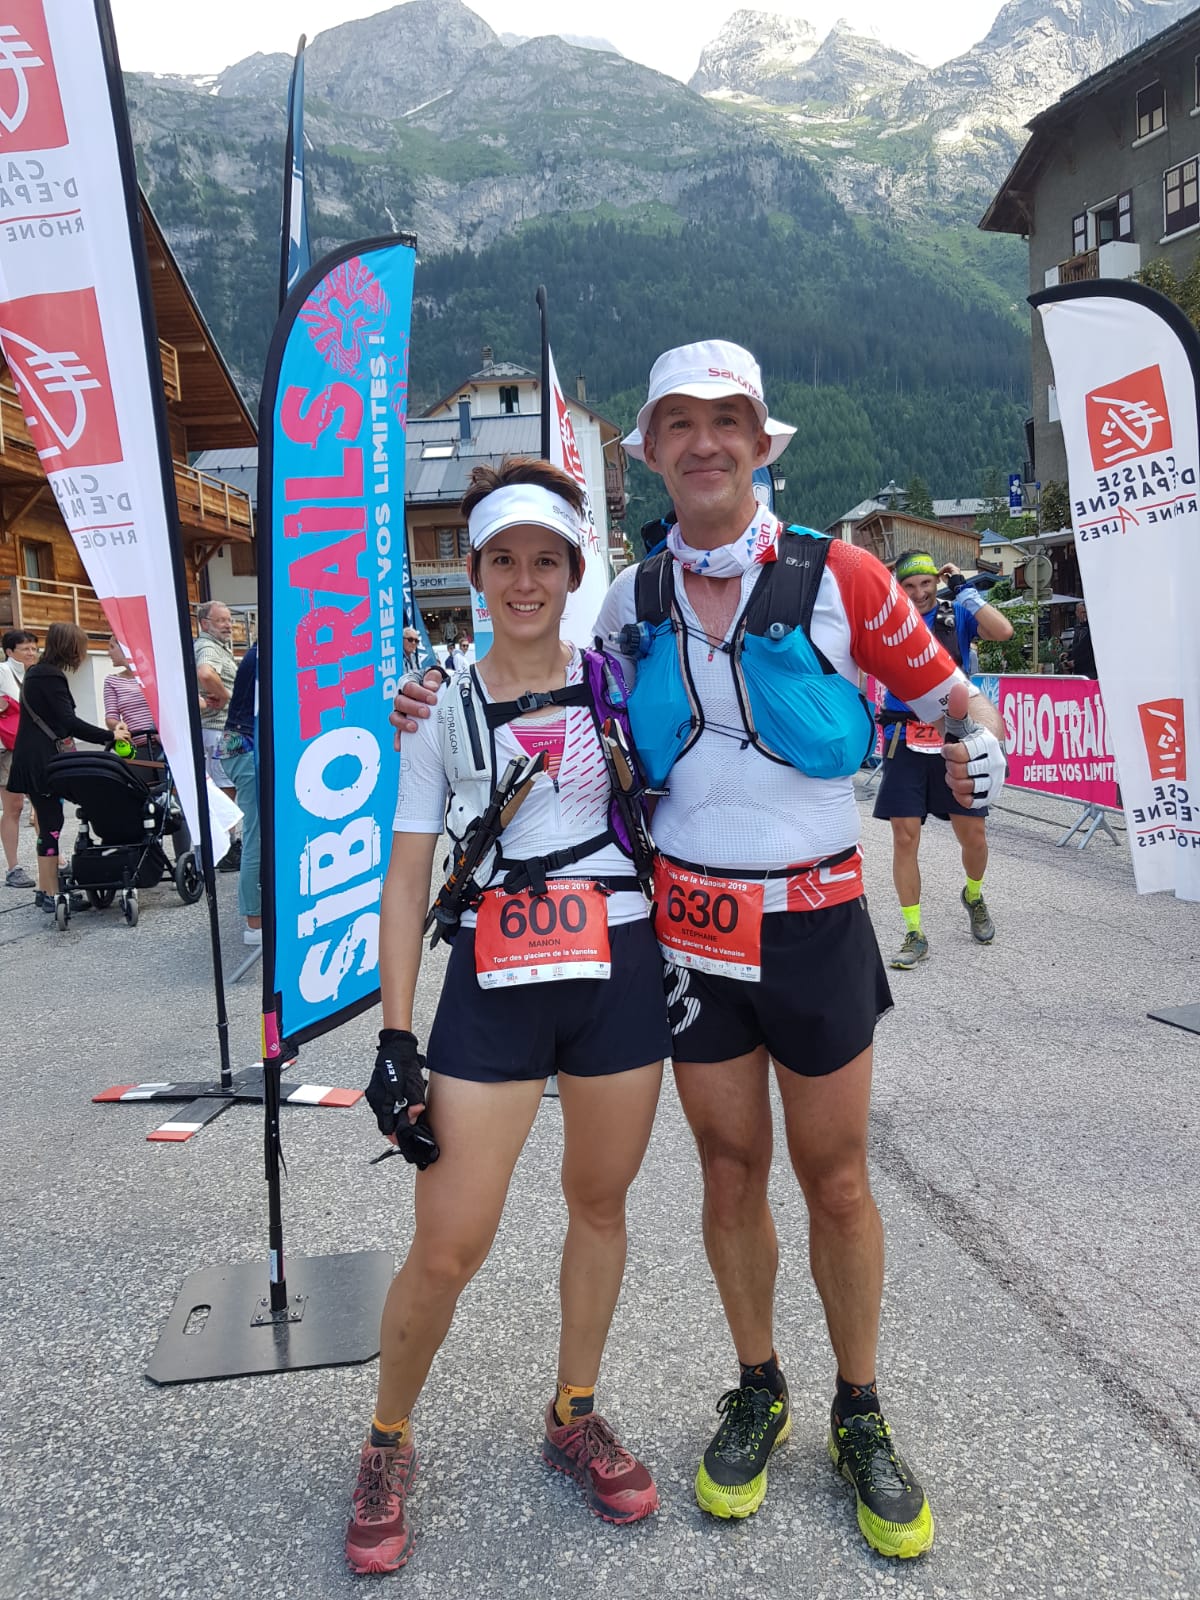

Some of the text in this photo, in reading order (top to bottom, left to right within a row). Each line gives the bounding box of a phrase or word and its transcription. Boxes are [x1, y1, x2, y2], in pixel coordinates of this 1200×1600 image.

[370, 355, 390, 494] LIMITES
[375, 503, 394, 580] VOS
[420, 578, 448, 587] SPORT
[378, 586, 399, 701] DÉFIEZ
[532, 739, 557, 748] CRAFT
[1023, 760, 1059, 782] DÉFIEZ
[1058, 763, 1083, 782] VOS
[572, 882, 590, 891] 2019
[680, 874, 689, 882] de
[690, 876, 697, 884] la
[699, 877, 726, 888] Vanoise
[727, 882, 747, 892] 2019
[500, 894, 588, 939] 600
[667, 884, 739, 934] 630
[528, 938, 561, 948] MANON
[671, 936, 681, 944] des
[682, 938, 703, 950] glaciers
[704, 944, 712, 952] de
[719, 948, 745, 958] Vanoise
[493, 956, 507, 964] Tour
[523, 951, 551, 961] glaciers
[552, 949, 562, 957] de
[570, 948, 598, 956] Vanoise
[385, 1059, 398, 1082] LEKI
